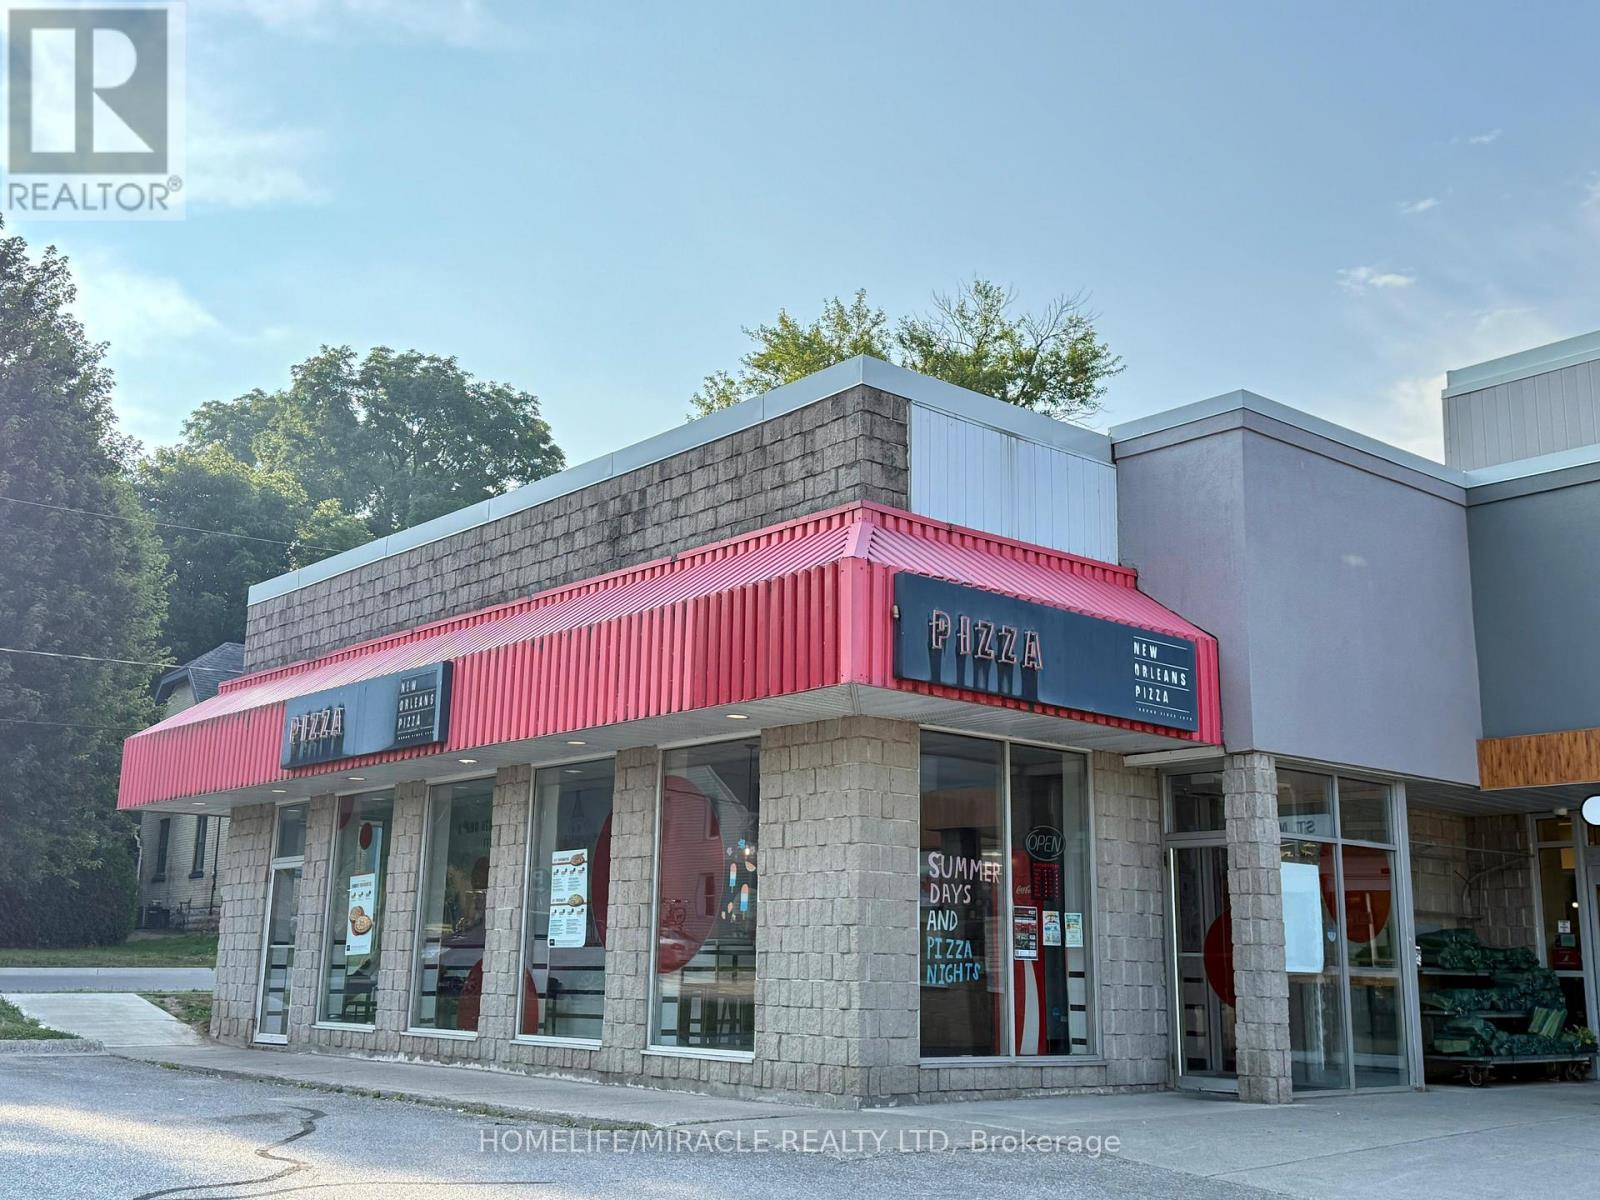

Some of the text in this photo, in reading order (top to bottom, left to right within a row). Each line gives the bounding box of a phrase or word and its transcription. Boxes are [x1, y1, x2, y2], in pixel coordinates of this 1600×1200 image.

[929, 608, 1043, 671] PIZZA
[1133, 641, 1158, 659] NEW
[1134, 663, 1187, 686] ORLEANS
[400, 680, 417, 693] NEW
[1135, 685, 1169, 704] PIZZA
[399, 693, 434, 711] ORLEANS
[289, 706, 345, 745] PIZZA
[398, 713, 420, 729] PIZZA
[1028, 834, 1062, 852] OPEN
[928, 851, 1001, 885] SUMMER
[930, 883, 972, 904] DAYS
[926, 909, 958, 932] AND
[926, 937, 973, 959] PIZZA
[926, 963, 982, 985] NIGHTS
